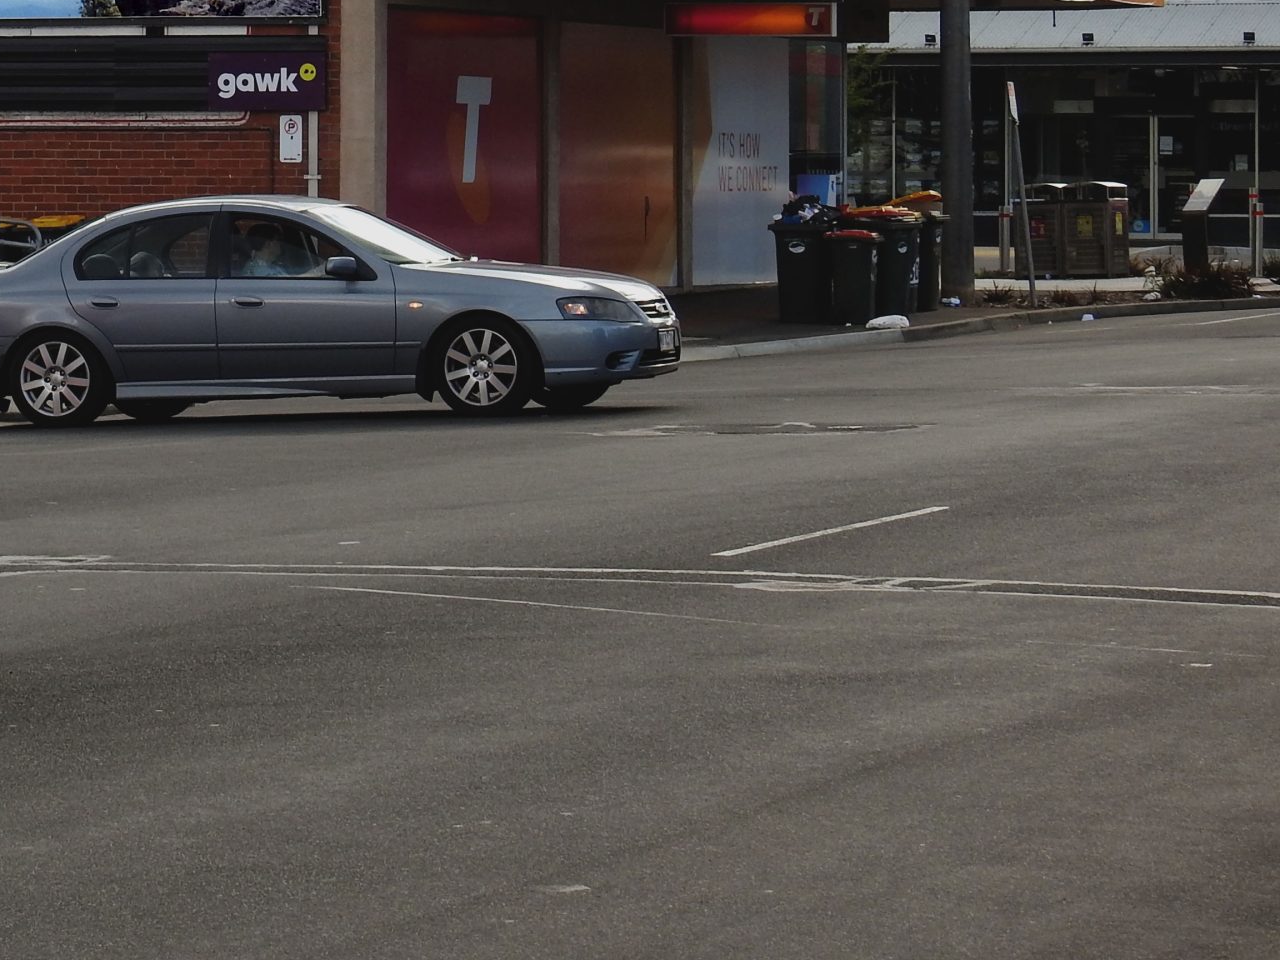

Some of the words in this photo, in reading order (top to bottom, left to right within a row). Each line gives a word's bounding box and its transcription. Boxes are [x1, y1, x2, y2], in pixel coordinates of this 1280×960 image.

[217, 67, 298, 99] gawk
[718, 132, 735, 159] IT'S
[739, 133, 760, 159] HOW
[718, 165, 733, 192] WE
[737, 166, 779, 192] CONNECT
